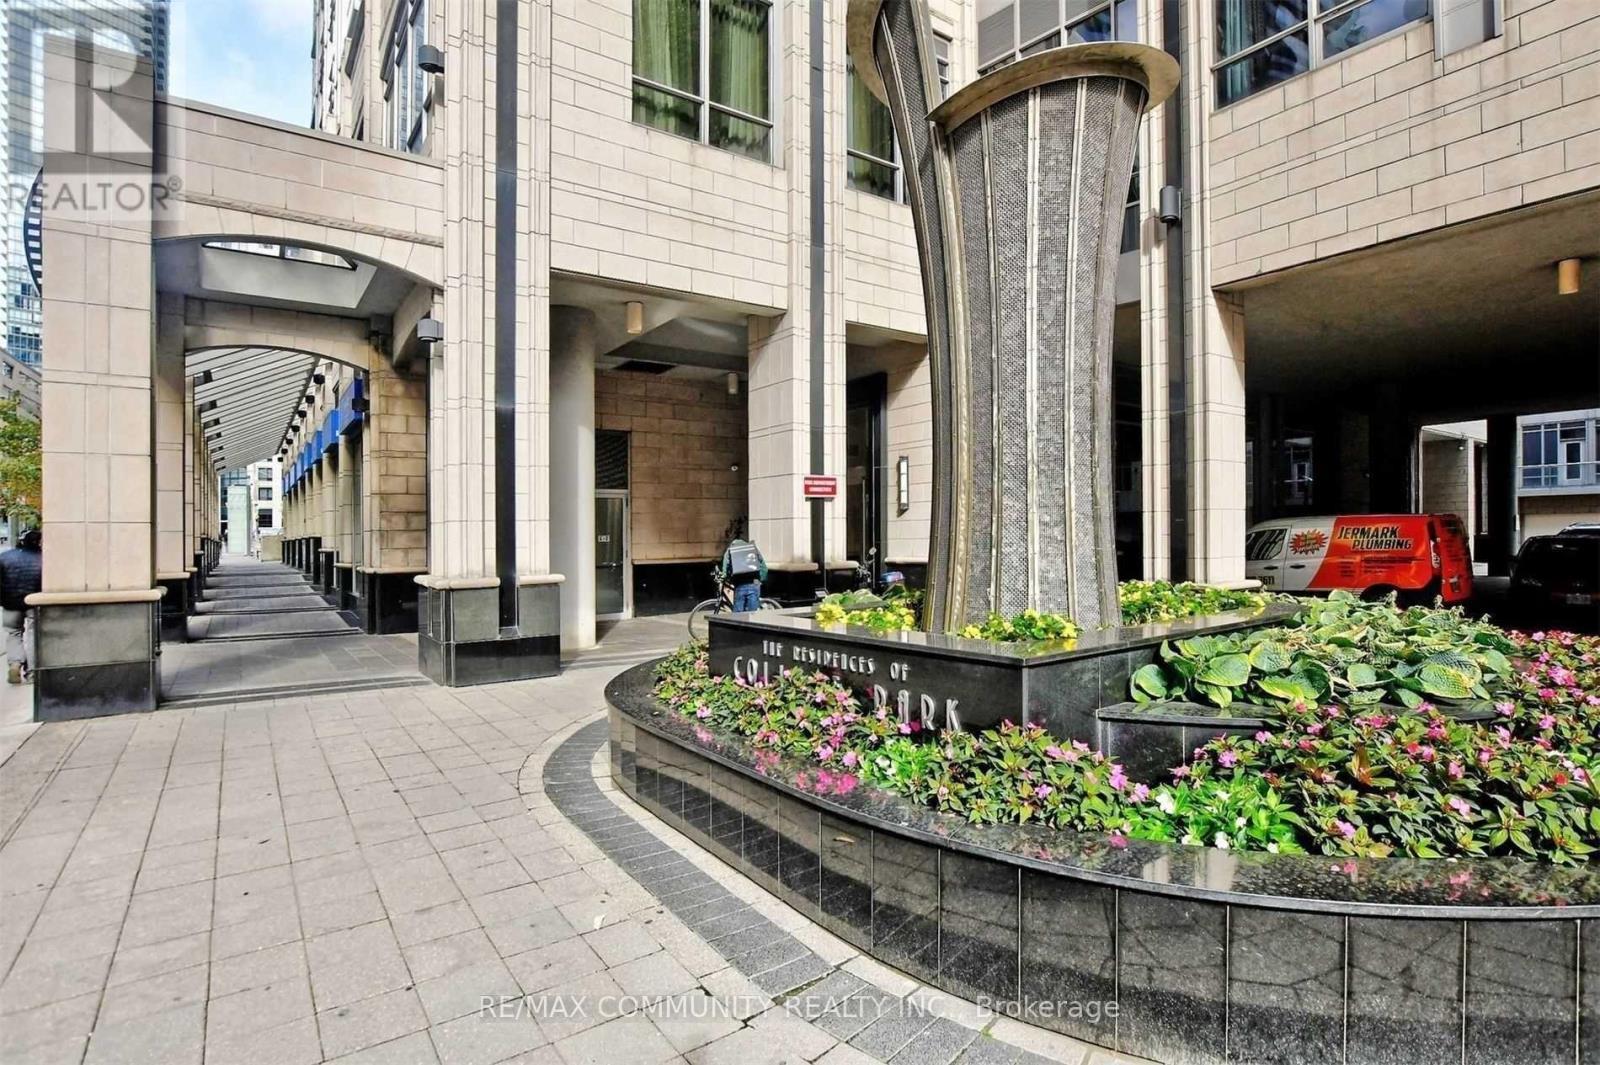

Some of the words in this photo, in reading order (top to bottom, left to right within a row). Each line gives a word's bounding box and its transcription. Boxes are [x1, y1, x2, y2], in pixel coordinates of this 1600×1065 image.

[1338, 526, 1399, 540] JERMARK
[1352, 539, 1413, 550] PLUMBING
[762, 640, 783, 657] THE
[793, 646, 876, 674] RESIDENCES
[890, 662, 911, 681] OF
[873, 684, 960, 732] PARK
